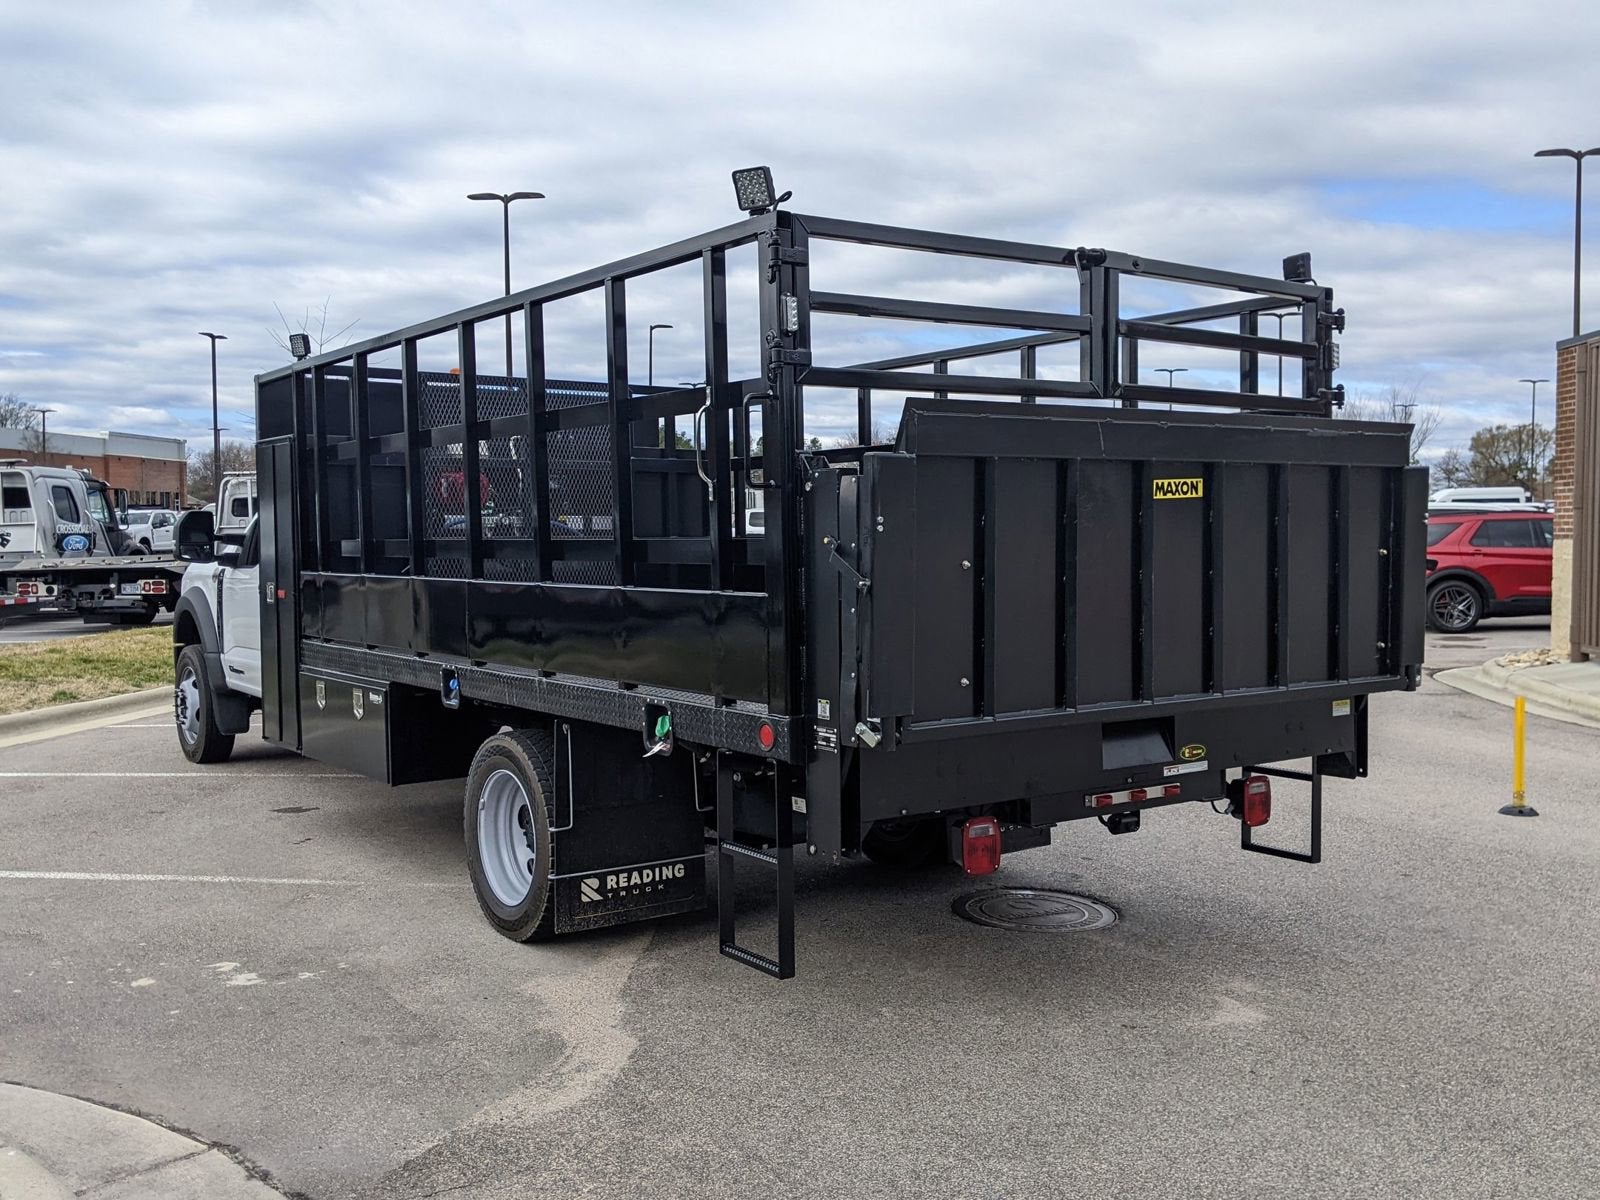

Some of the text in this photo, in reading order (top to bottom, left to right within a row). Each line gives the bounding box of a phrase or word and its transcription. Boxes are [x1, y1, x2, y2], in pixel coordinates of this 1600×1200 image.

[1154, 480, 1199, 497] MAXON
[68, 537, 84, 550] Ford
[606, 863, 685, 890] READING
[607, 884, 665, 899] TRUCK
